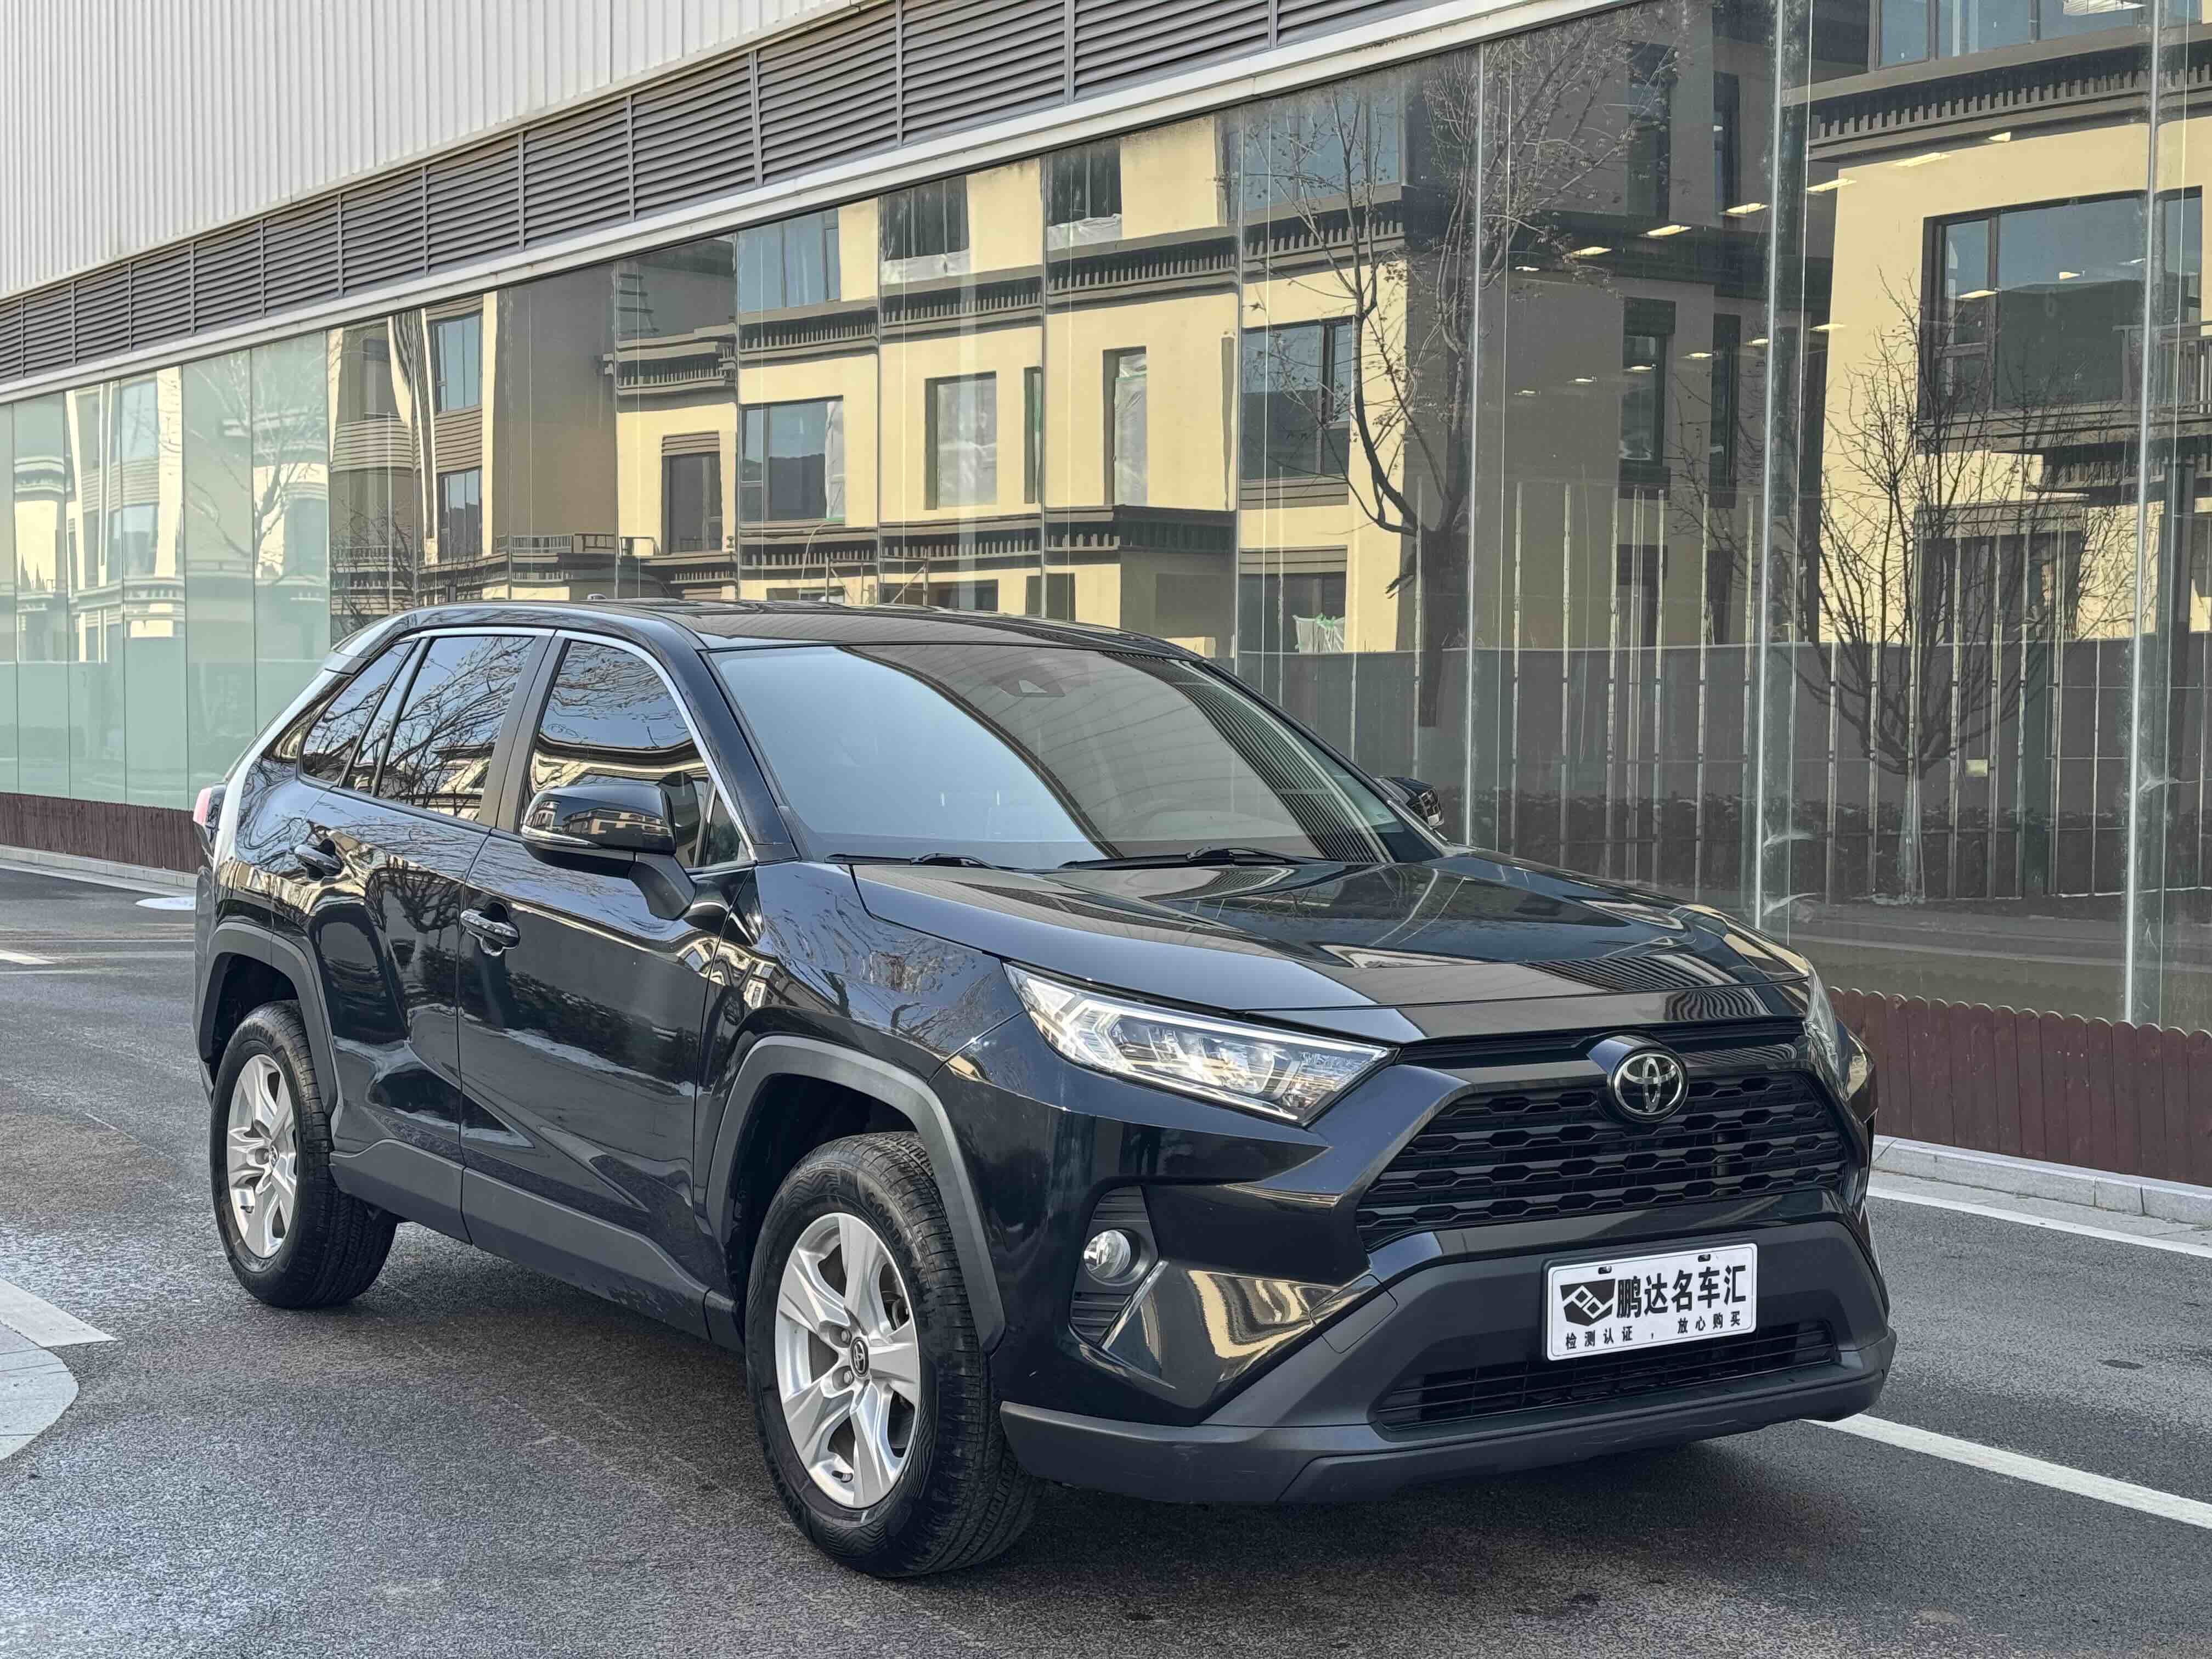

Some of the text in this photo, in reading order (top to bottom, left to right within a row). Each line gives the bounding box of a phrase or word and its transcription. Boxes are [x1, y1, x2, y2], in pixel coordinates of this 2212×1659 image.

[1616, 1265, 1747, 1319] 鹏达名车汇
